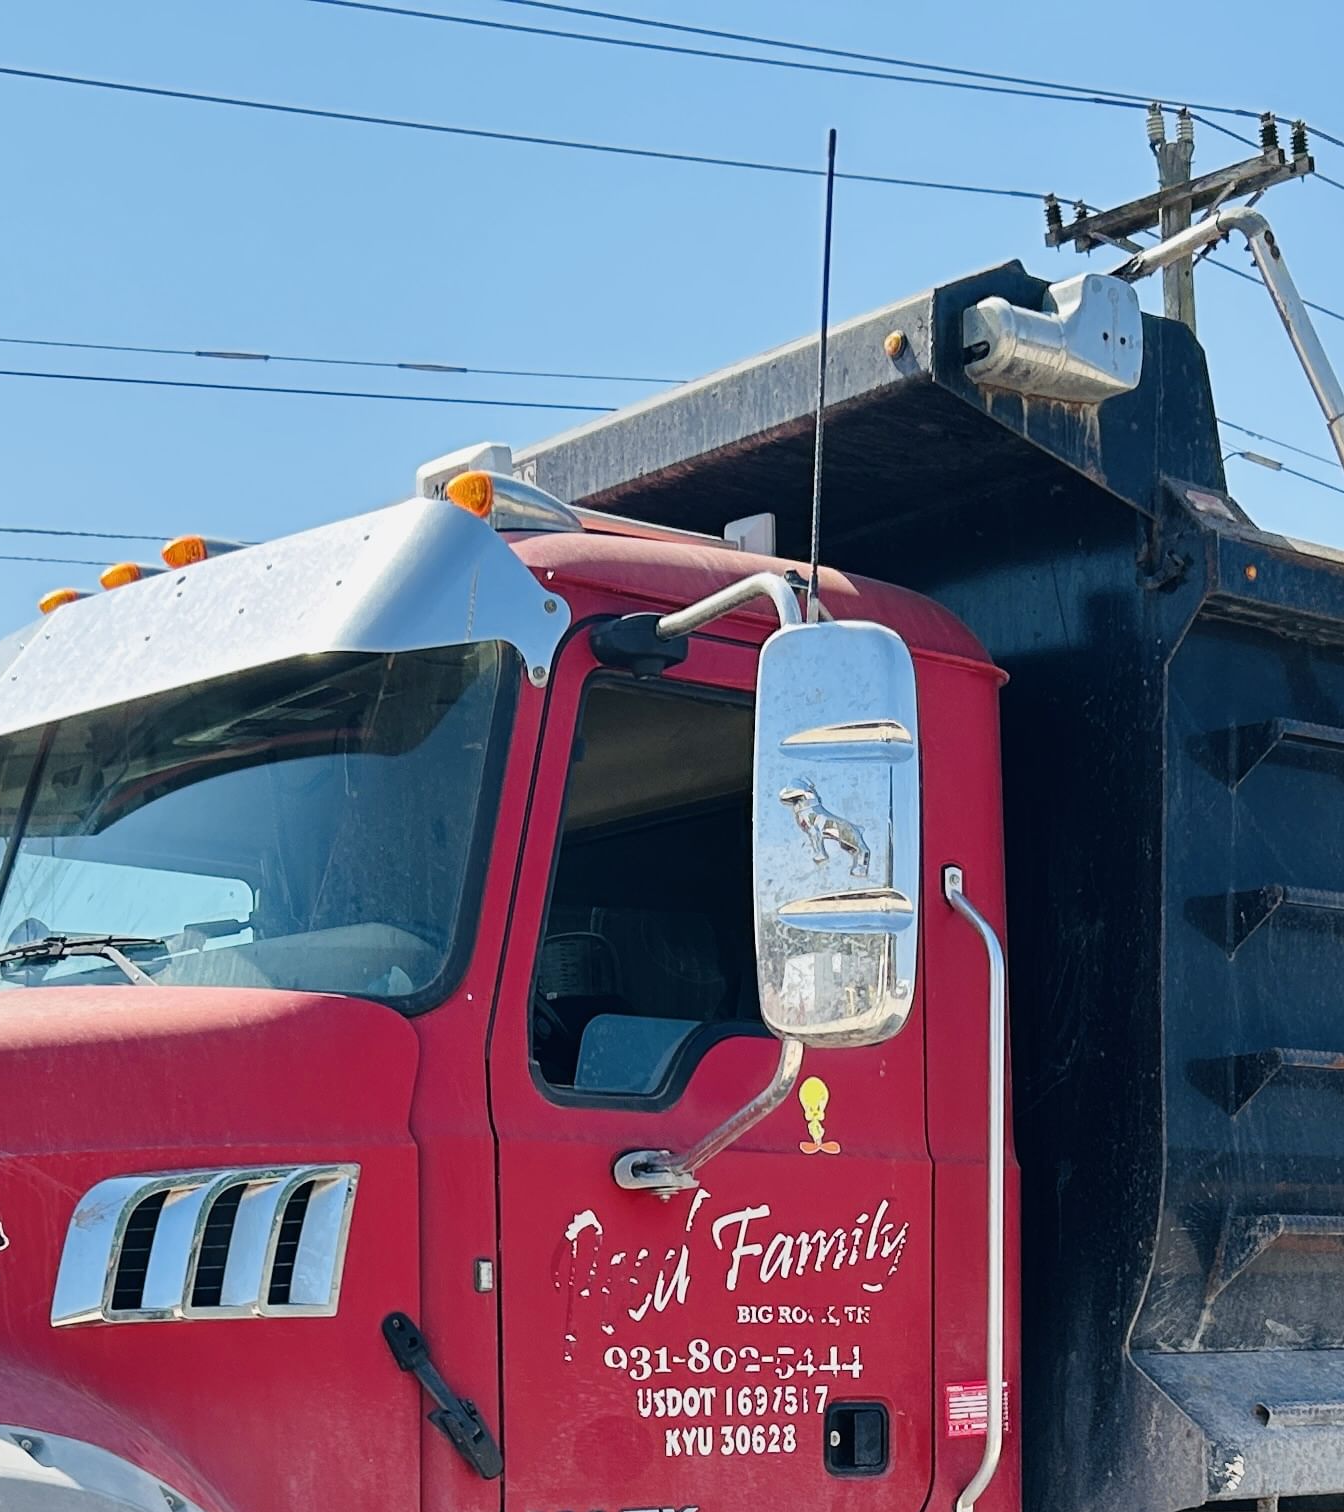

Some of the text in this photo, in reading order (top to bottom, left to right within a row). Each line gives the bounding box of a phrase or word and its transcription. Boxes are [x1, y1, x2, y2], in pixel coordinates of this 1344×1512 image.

[712, 1200, 909, 1292] Family
[737, 1305, 773, 1323] BIG
[637, 1387, 716, 1418] USDOT
[665, 1423, 797, 1457] KYU 30628
